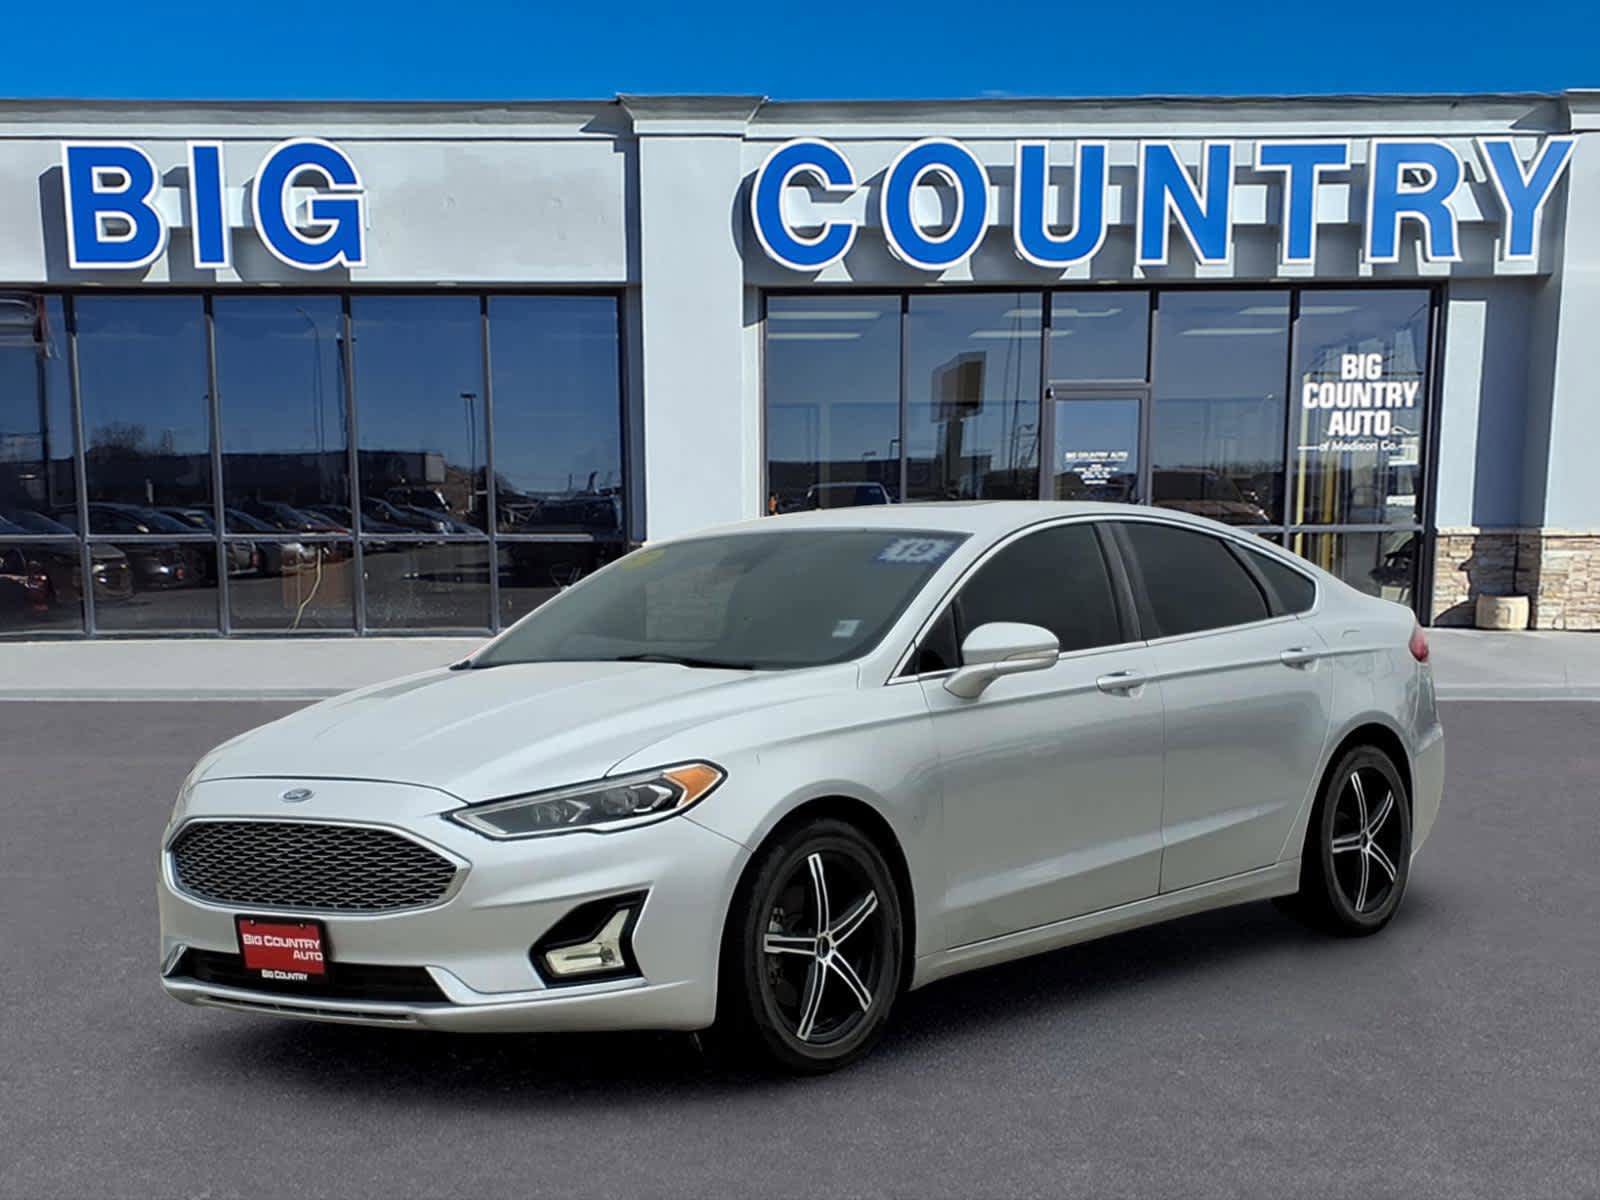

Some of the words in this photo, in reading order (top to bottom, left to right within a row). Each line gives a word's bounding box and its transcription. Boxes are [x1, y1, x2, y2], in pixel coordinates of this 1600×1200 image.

[61, 137, 367, 271] BIG
[751, 136, 1575, 271] COUNTRY
[1341, 353, 1382, 380] BIG
[1303, 381, 1419, 409] COUNTRY
[1327, 410, 1391, 437] AUTO
[1331, 440, 1378, 451] Madison
[243, 934, 262, 945] BIG
[264, 935, 320, 949] COUNTRY
[293, 950, 324, 961] AUTO
[275, 970, 308, 980] COUNTRY
